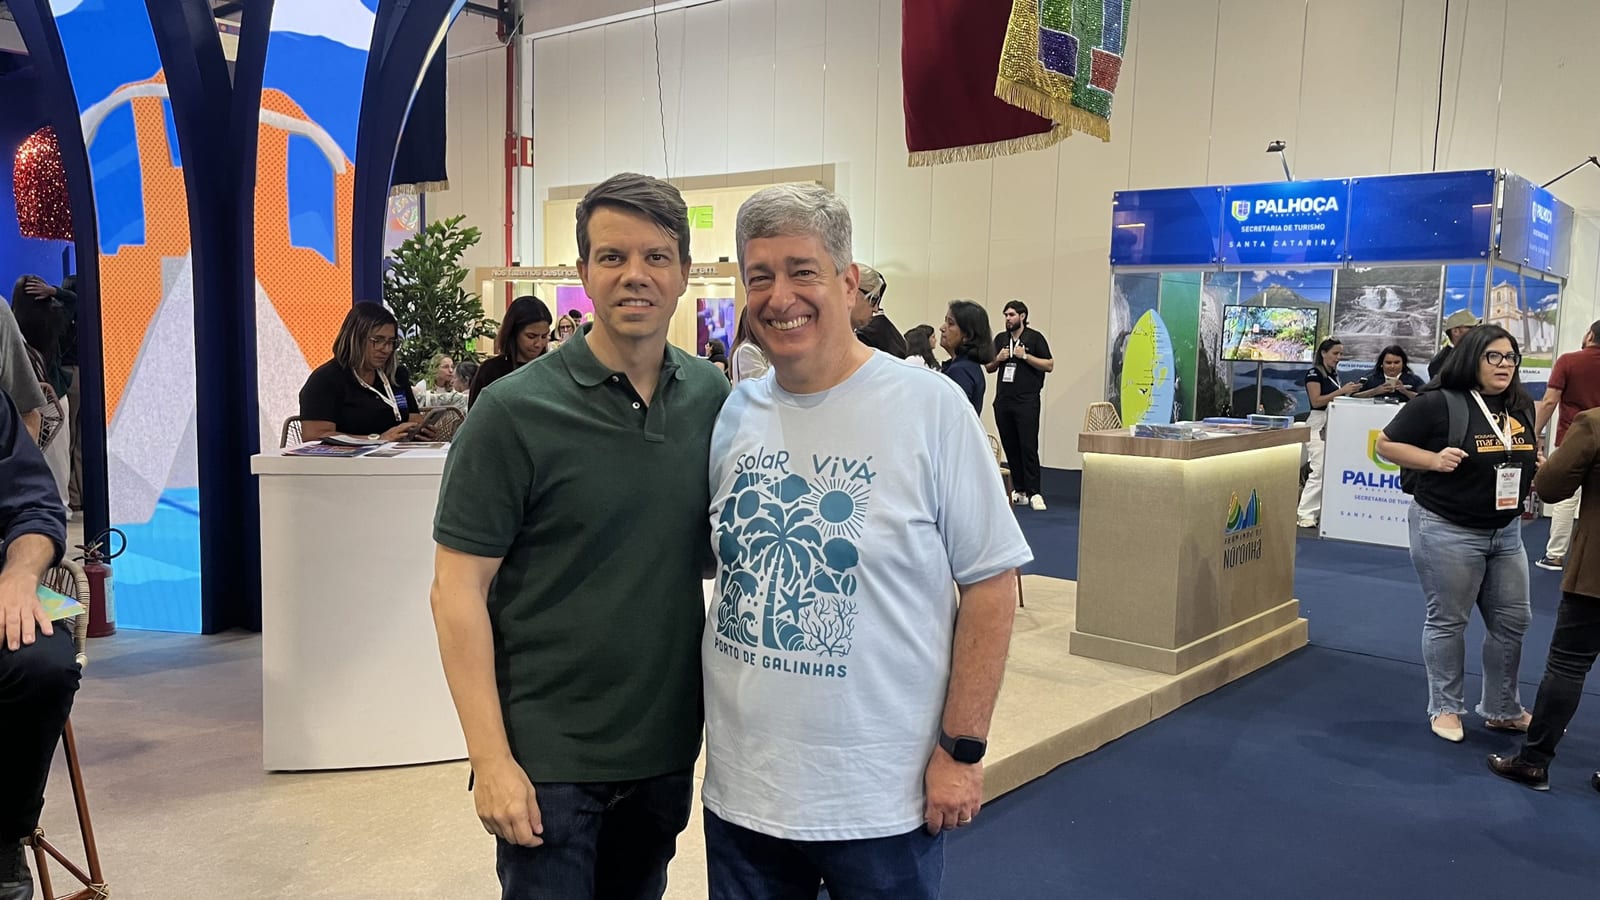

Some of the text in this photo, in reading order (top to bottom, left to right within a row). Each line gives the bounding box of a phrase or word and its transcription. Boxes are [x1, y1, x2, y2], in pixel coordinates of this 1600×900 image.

[1255, 197, 1339, 214] PALHOÇA
[1241, 224, 1282, 233] SECRETARIA
[1294, 223, 1326, 231] TURISMO
[1228, 238, 1336, 248] SANTA CATARINA
[1354, 494, 1387, 504] SECRETARIA
[1340, 510, 1406, 523] SANTA CATA
[714, 637, 847, 678] PORTO DE GALINHAS
